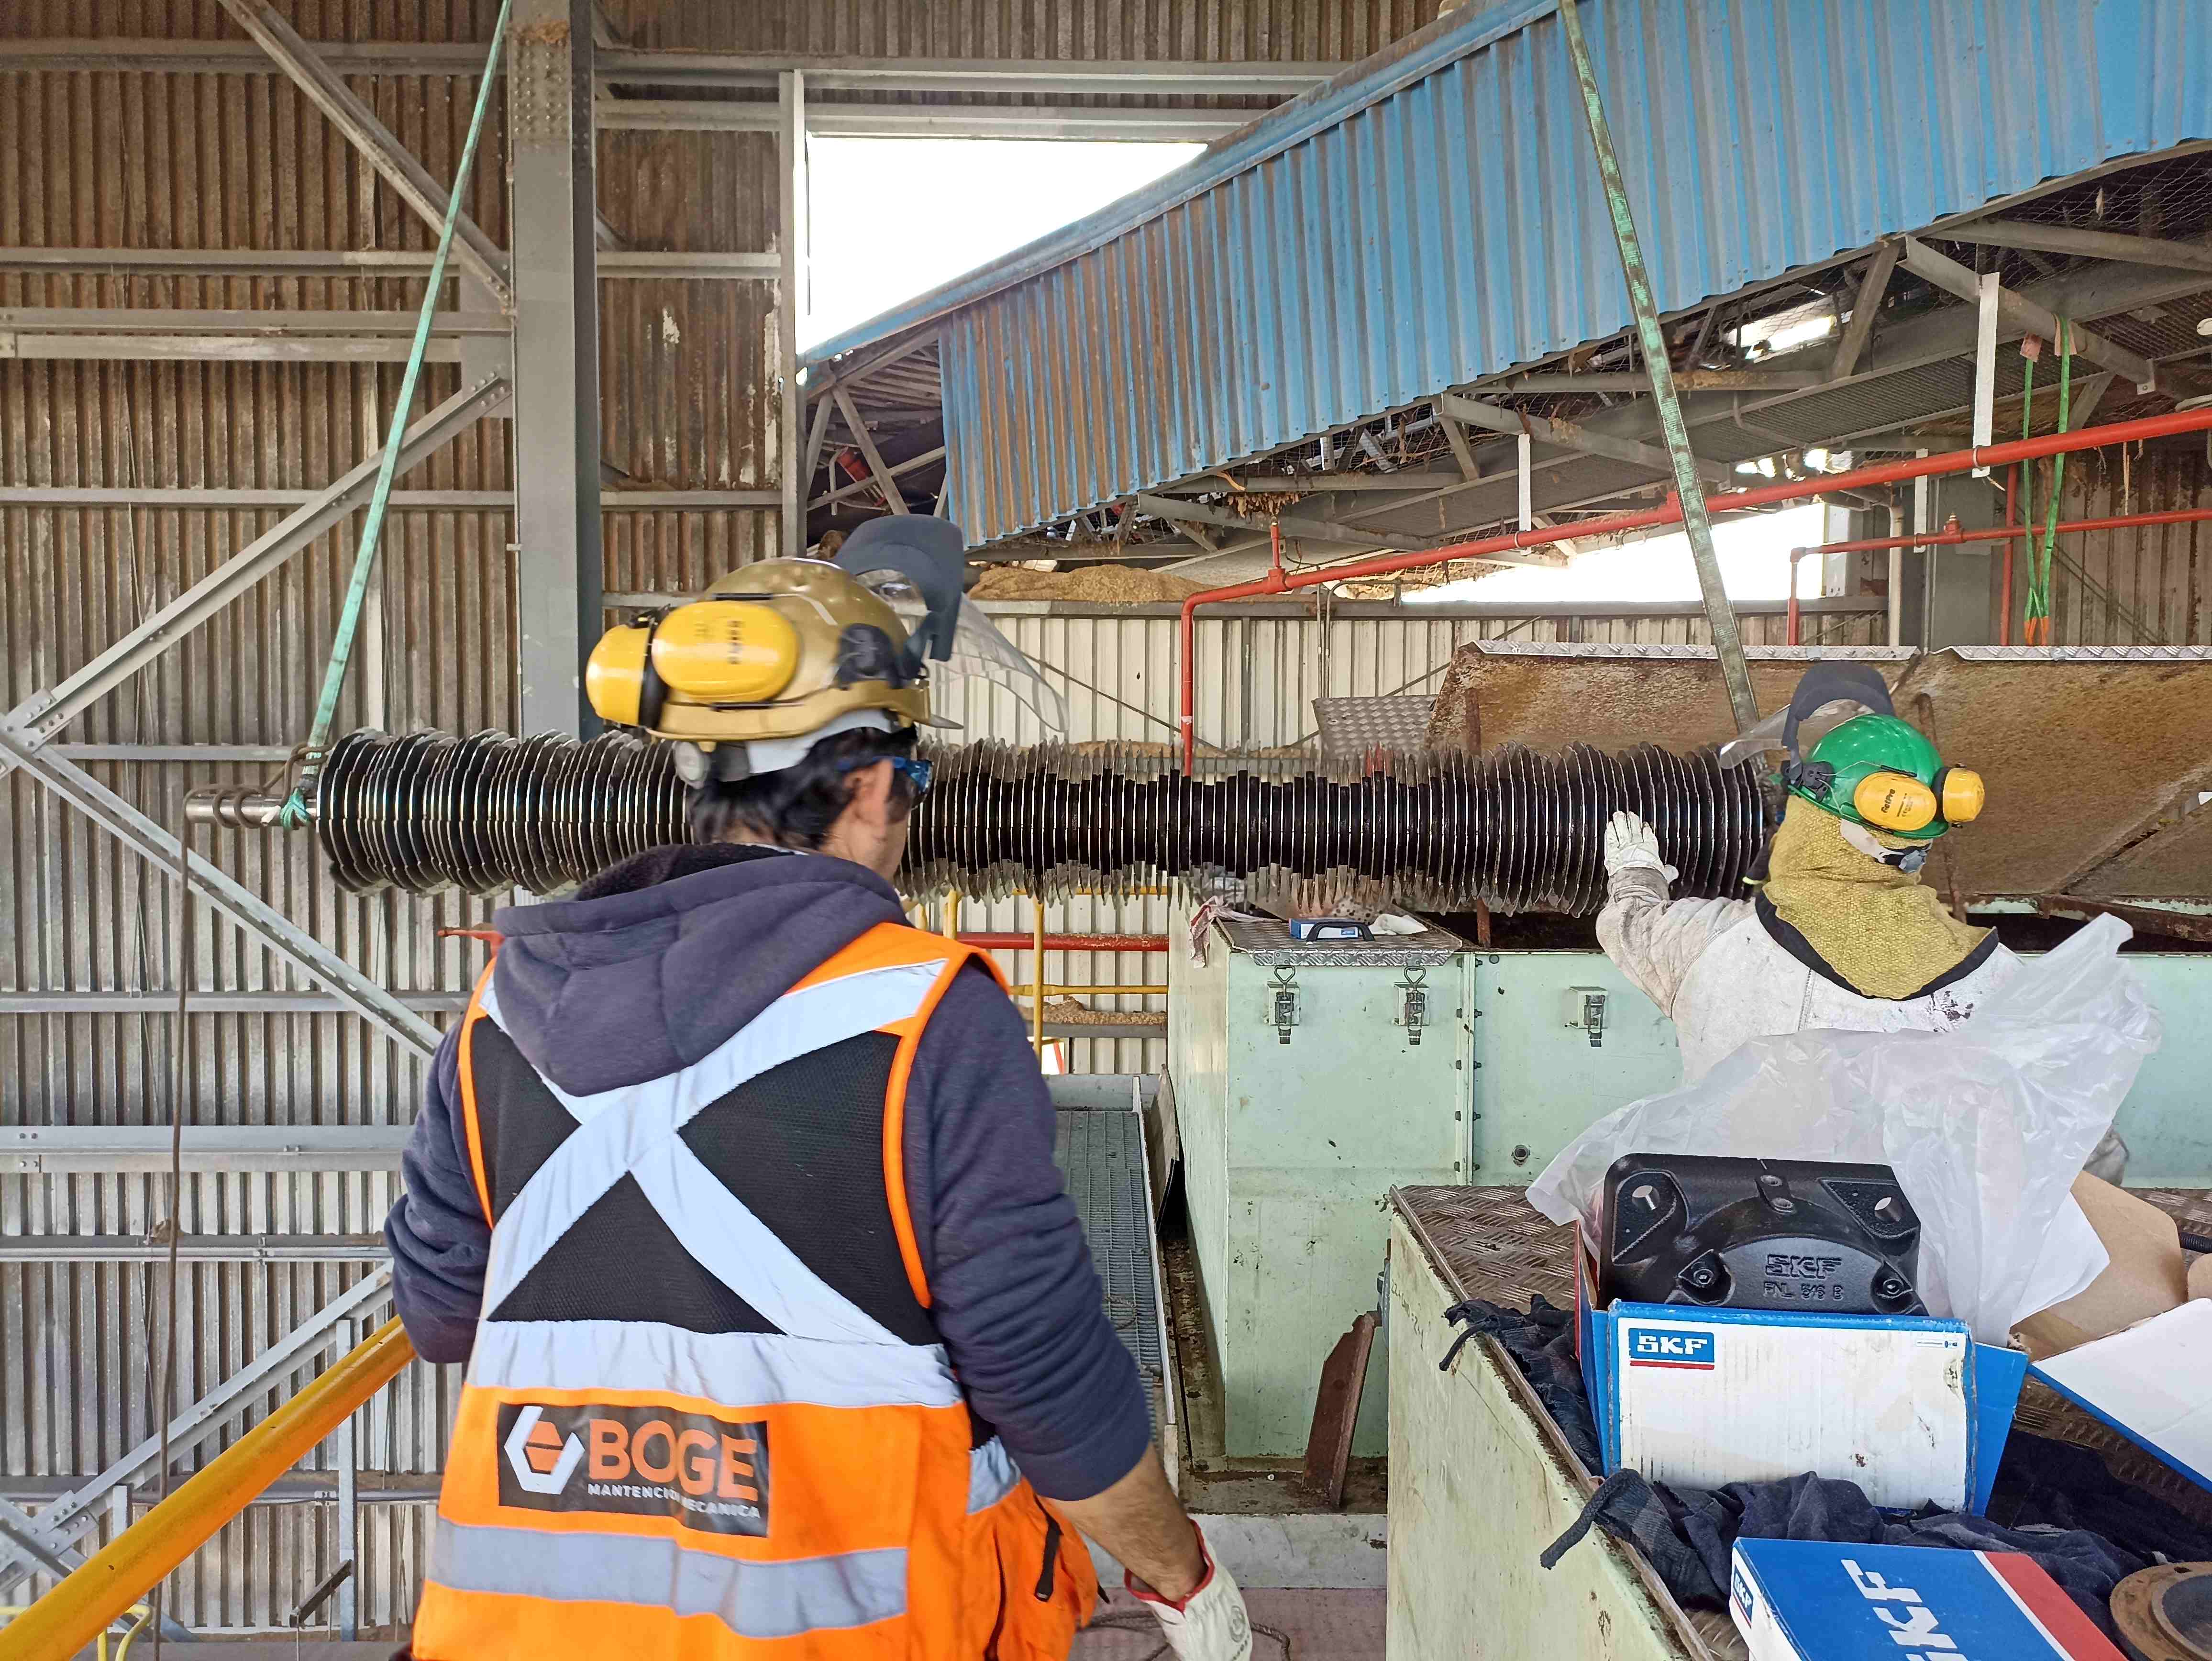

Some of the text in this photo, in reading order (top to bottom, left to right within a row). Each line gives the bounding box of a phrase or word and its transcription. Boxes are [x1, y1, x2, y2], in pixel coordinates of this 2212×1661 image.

[1766, 1254, 1842, 1279] SKF
[1763, 1281, 1795, 1298] FNL
[1833, 1284, 1844, 1300] B
[1637, 1335, 1708, 1355] SKF
[589, 1419, 758, 1502] BOGE
[1734, 1572, 1752, 1608] SKF
[1841, 1559, 1969, 1661] KF
